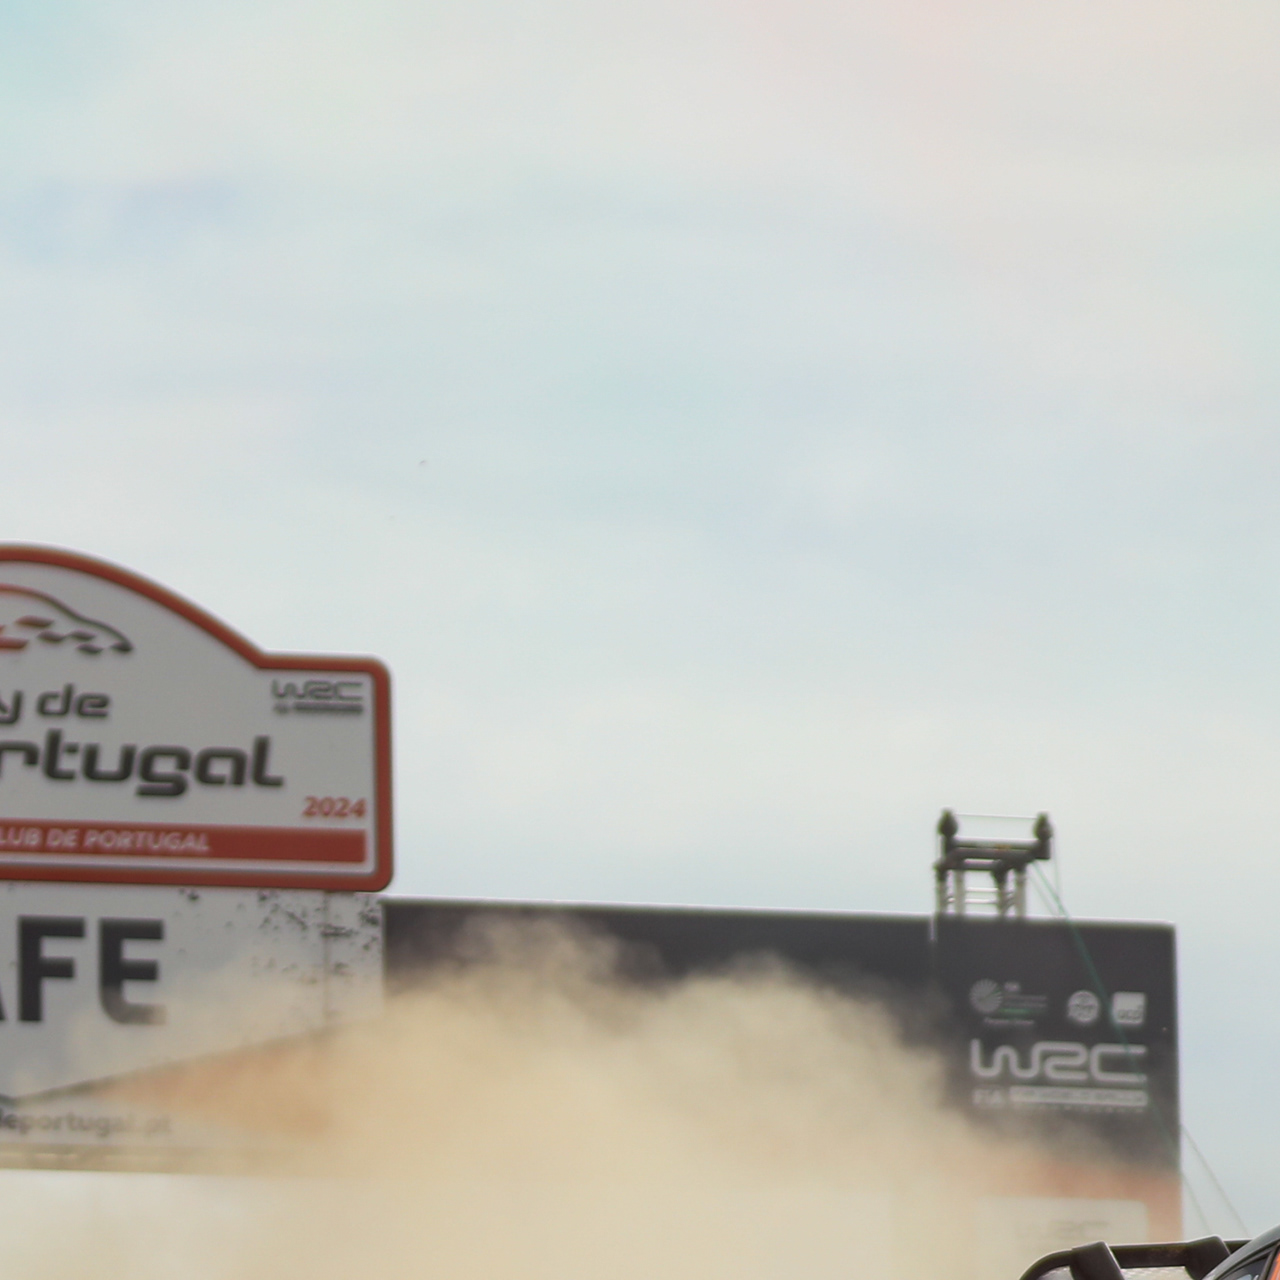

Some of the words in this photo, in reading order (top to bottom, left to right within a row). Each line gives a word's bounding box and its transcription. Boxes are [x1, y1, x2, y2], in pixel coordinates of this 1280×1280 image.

[37, 684, 110, 718] de
[302, 796, 367, 818] 2024
[46, 829, 79, 847] DE
[84, 829, 209, 850] PORTUGAL
